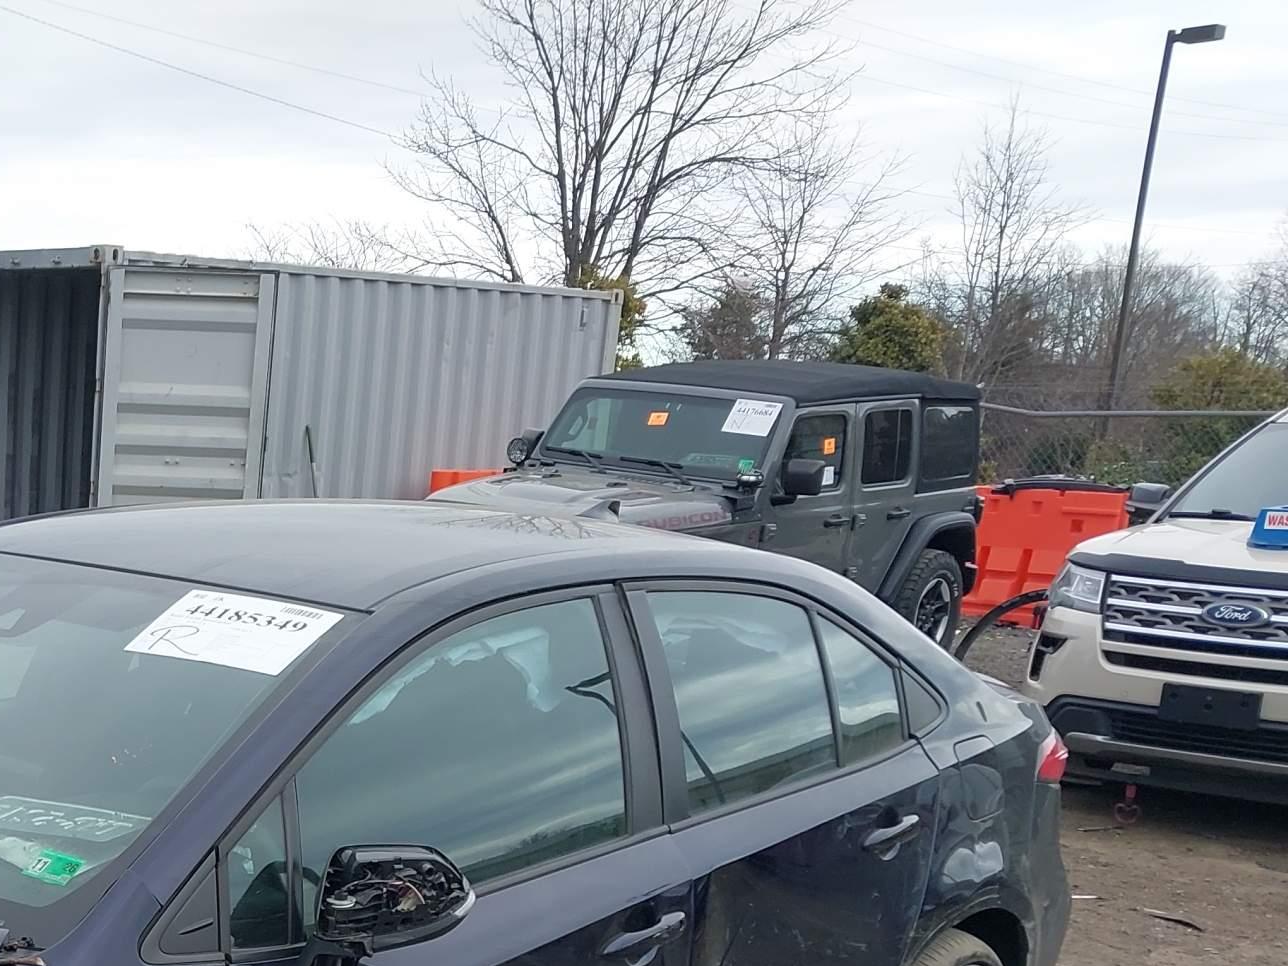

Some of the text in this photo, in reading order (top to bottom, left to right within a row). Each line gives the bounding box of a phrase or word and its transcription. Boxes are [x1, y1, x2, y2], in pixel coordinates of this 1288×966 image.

[186, 604, 308, 632] 44185349
[1214, 605, 1252, 621] Ford
[149, 625, 200, 656] R
